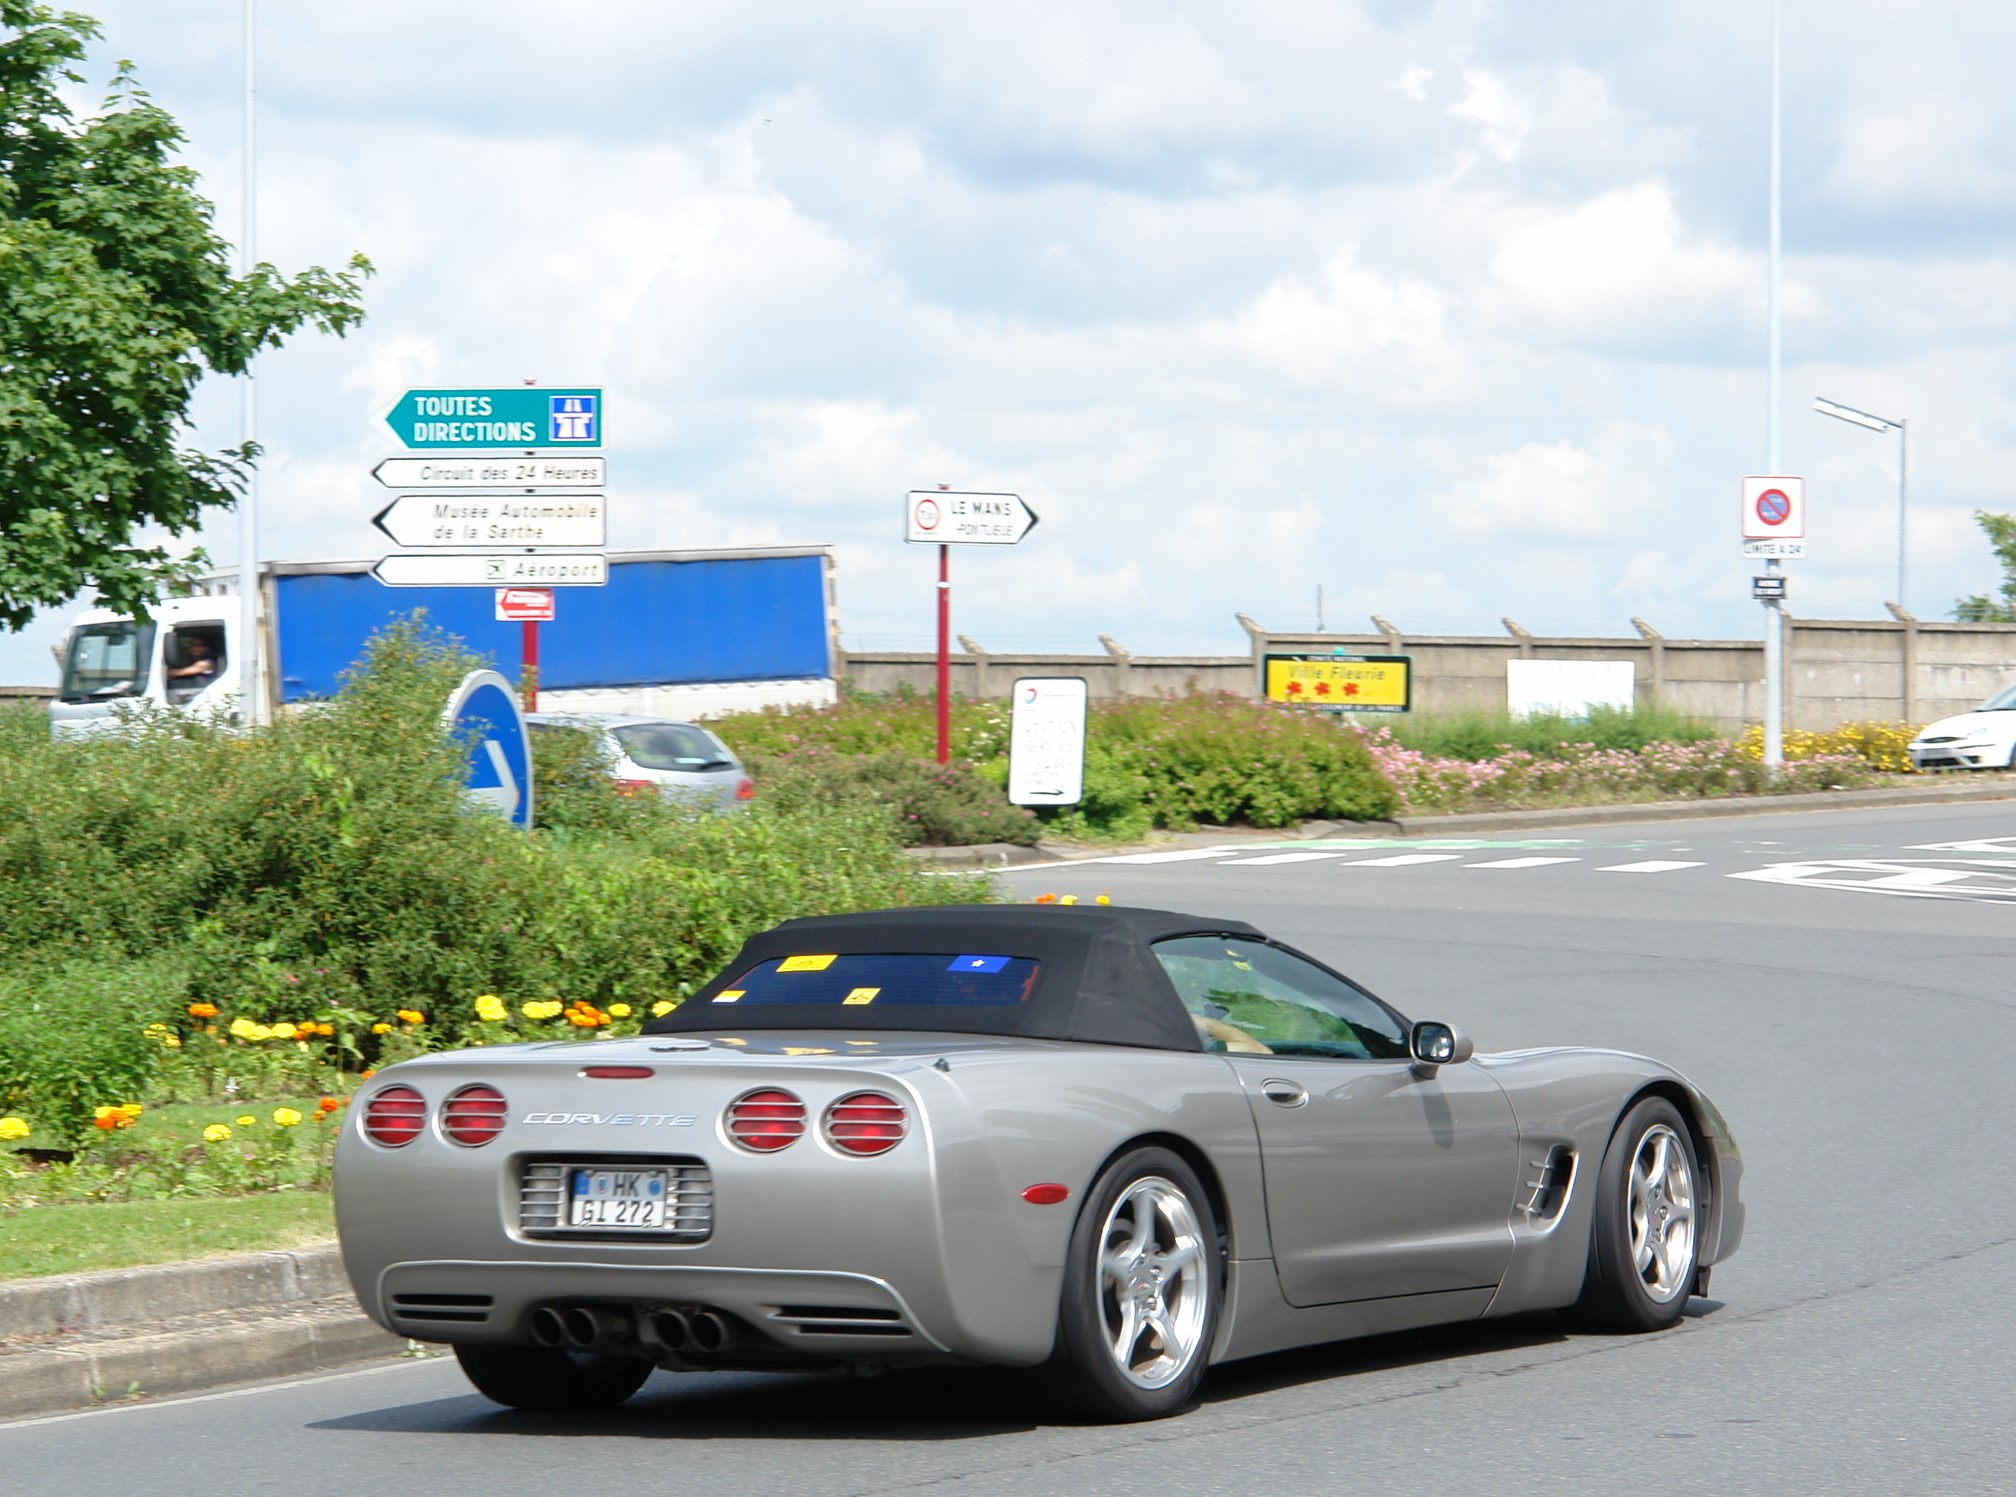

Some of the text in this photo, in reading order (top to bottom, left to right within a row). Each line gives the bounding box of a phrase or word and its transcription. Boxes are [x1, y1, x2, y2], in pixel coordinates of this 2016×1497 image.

[414, 396, 492, 416] TOUTES
[413, 422, 537, 442] DIRECTIONS
[420, 465, 599, 480] Circuit des 24 Heures
[432, 503, 599, 518] Musée Automobile
[951, 500, 966, 515] LE
[973, 501, 1011, 516] MANS
[433, 525, 545, 539] de la Sarthe
[513, 562, 598, 579] Aéroport
[522, 1112, 700, 1127] CORVETTE
[612, 1174, 641, 1197] HK
[615, 1200, 653, 1222] 272
